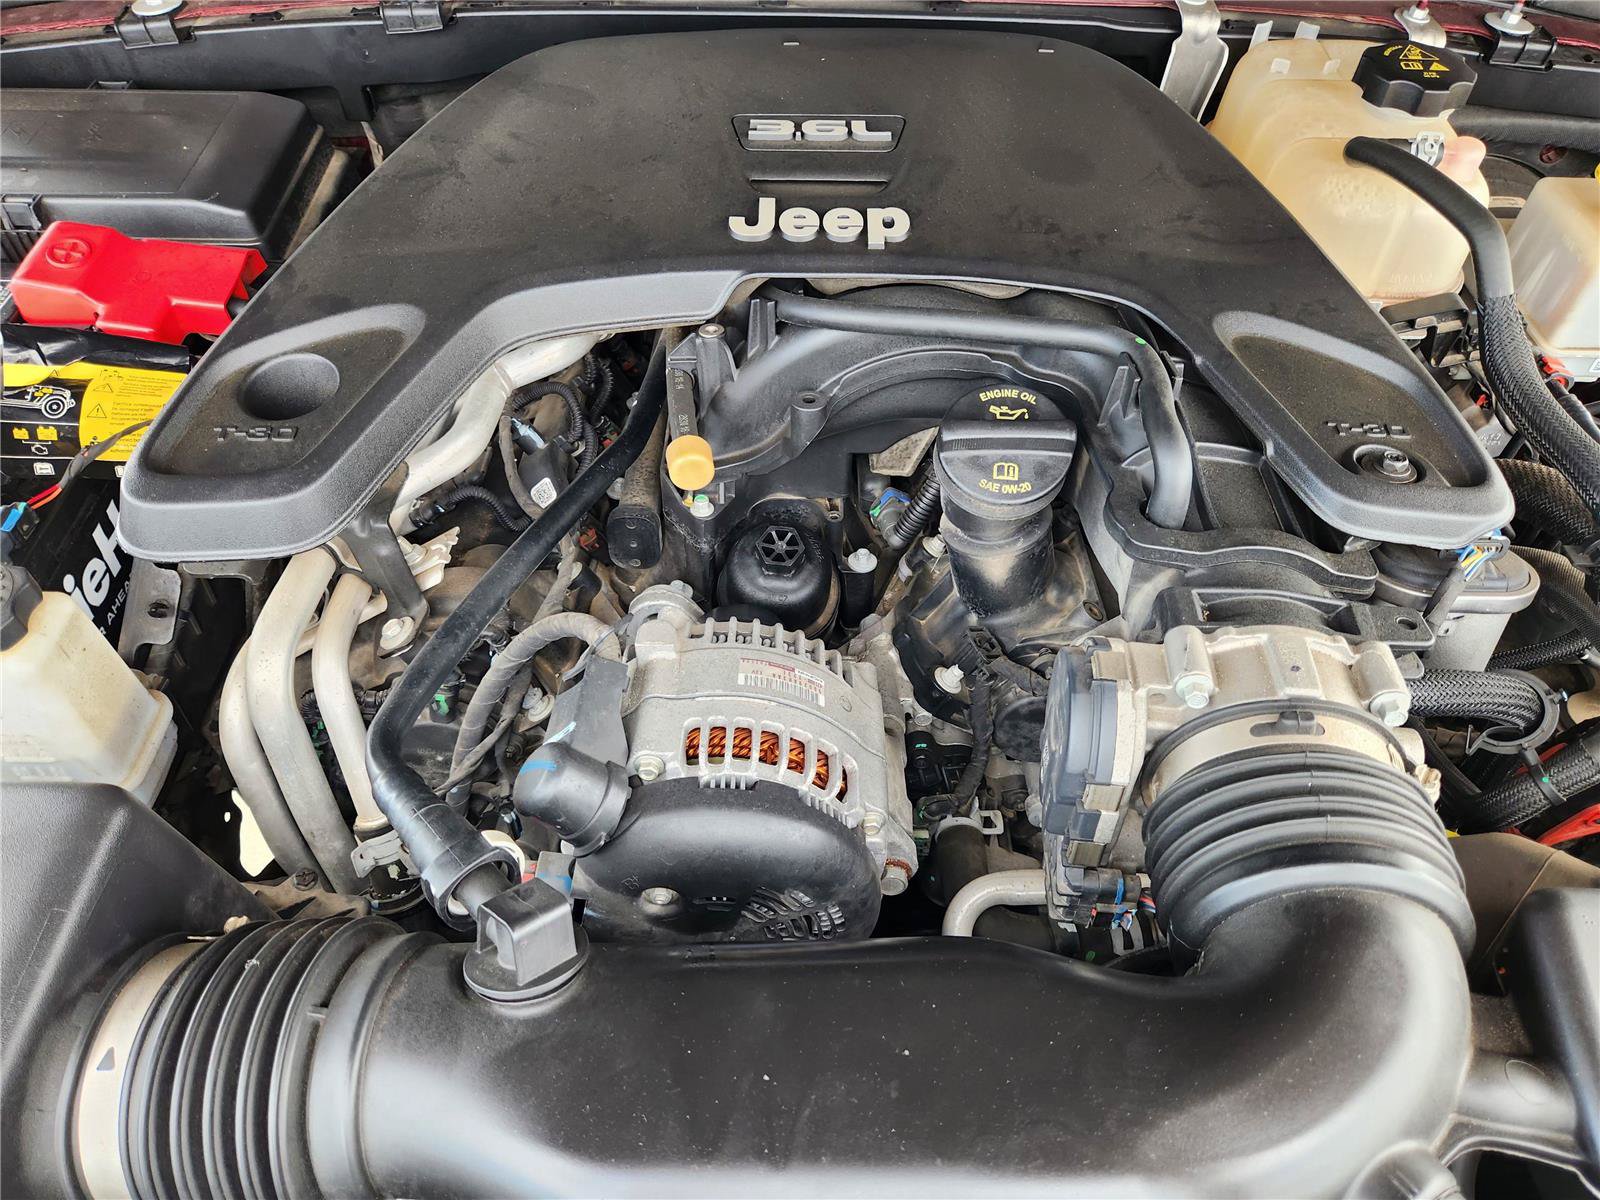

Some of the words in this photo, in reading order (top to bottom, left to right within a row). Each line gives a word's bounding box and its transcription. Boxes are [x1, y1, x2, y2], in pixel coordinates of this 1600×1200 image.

[748, 119, 892, 141] 3.6L
[728, 197, 910, 249] Jeep
[979, 388, 1019, 402] ENGINE
[1020, 393, 1037, 405] OIL
[213, 424, 299, 442] T-30
[1323, 419, 1412, 440] T-30
[978, 478, 1000, 493] SAE
[1001, 481, 1032, 494] 0W-20
[63, 499, 121, 621] ieH
[107, 580, 130, 626] AHEA
